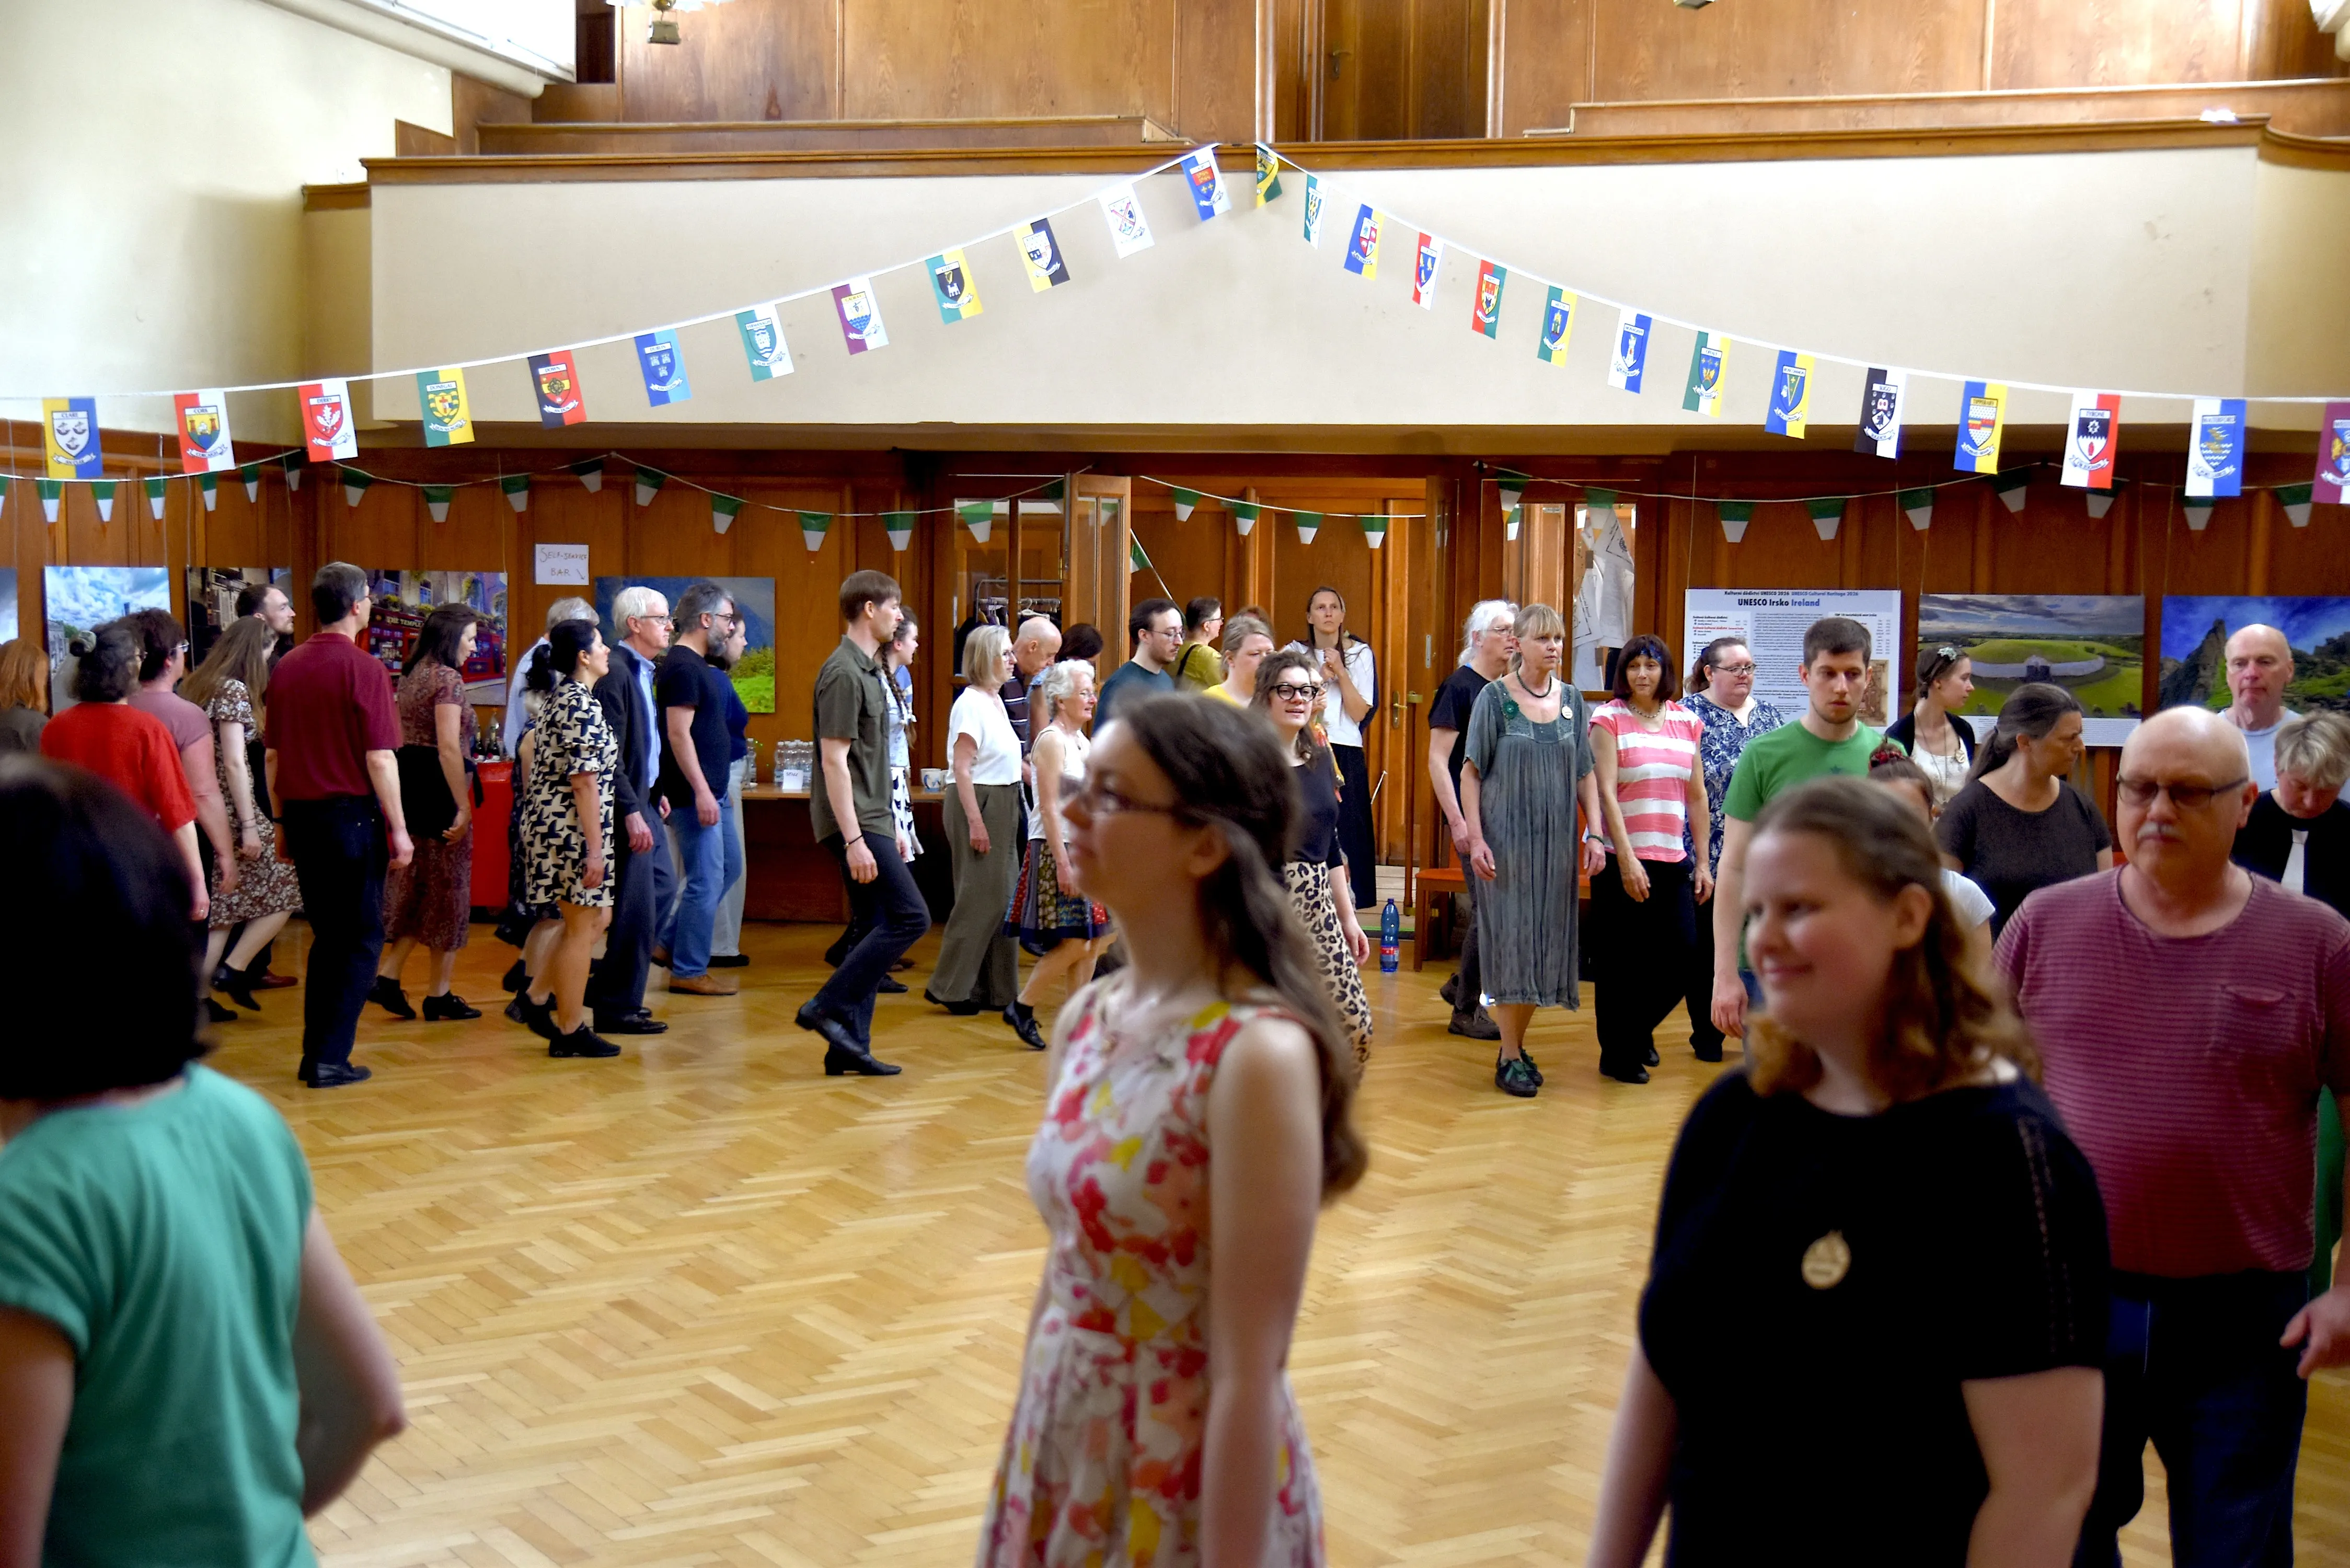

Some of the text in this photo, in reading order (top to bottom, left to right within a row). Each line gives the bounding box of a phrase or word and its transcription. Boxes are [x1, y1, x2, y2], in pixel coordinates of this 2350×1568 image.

[551, 567, 571, 577] BAR
[1769, 598, 1789, 606] Irsko
[1791, 598, 1820, 606] Ireland
[387, 616, 399, 625] THE
